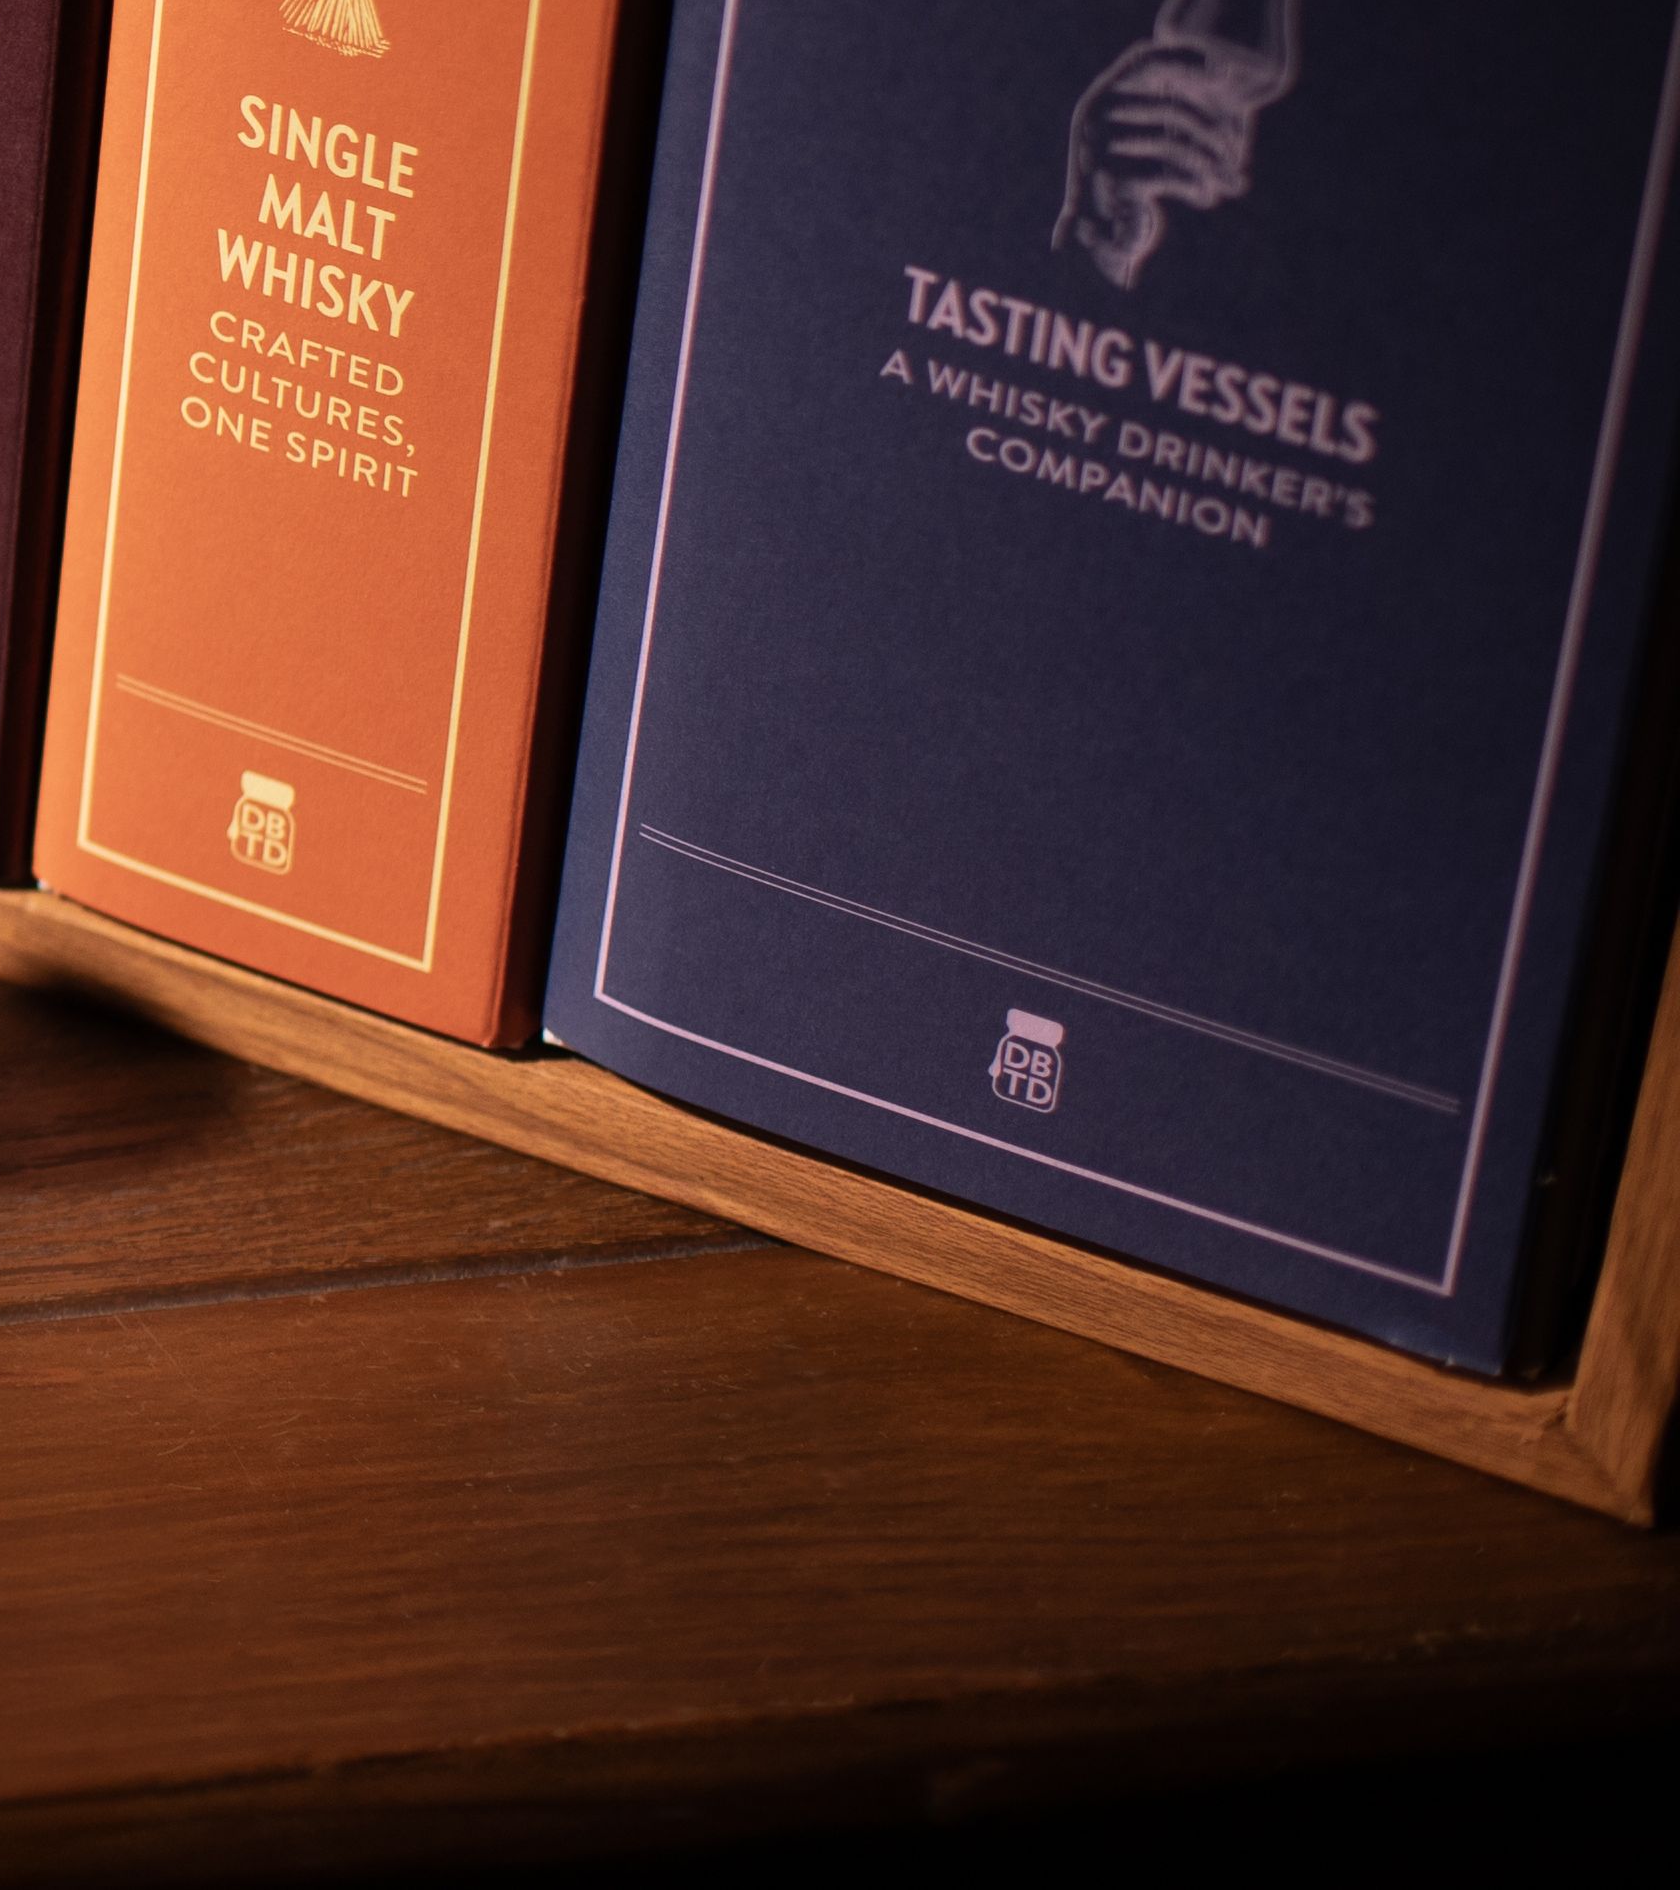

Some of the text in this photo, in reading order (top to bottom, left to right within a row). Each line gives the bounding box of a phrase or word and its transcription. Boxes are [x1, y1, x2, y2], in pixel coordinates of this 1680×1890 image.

[237, 94, 419, 198] SINGLE
[258, 173, 396, 261] MALT
[217, 228, 415, 338] WHISKY
[188, 351, 417, 459] CULTURES,
[210, 310, 405, 397] CRAFTED
[904, 265, 1380, 463] TASTING VESSELS
[180, 395, 419, 498] ONE SPIRIT
[880, 349, 1377, 529] A WHISKY DRINKER'S
[966, 427, 1271, 547] COMPANION
[240, 831, 287, 867] TD
[241, 804, 286, 839] DB
[1003, 1068, 1052, 1105] TD
[1004, 1041, 1052, 1078] DB
